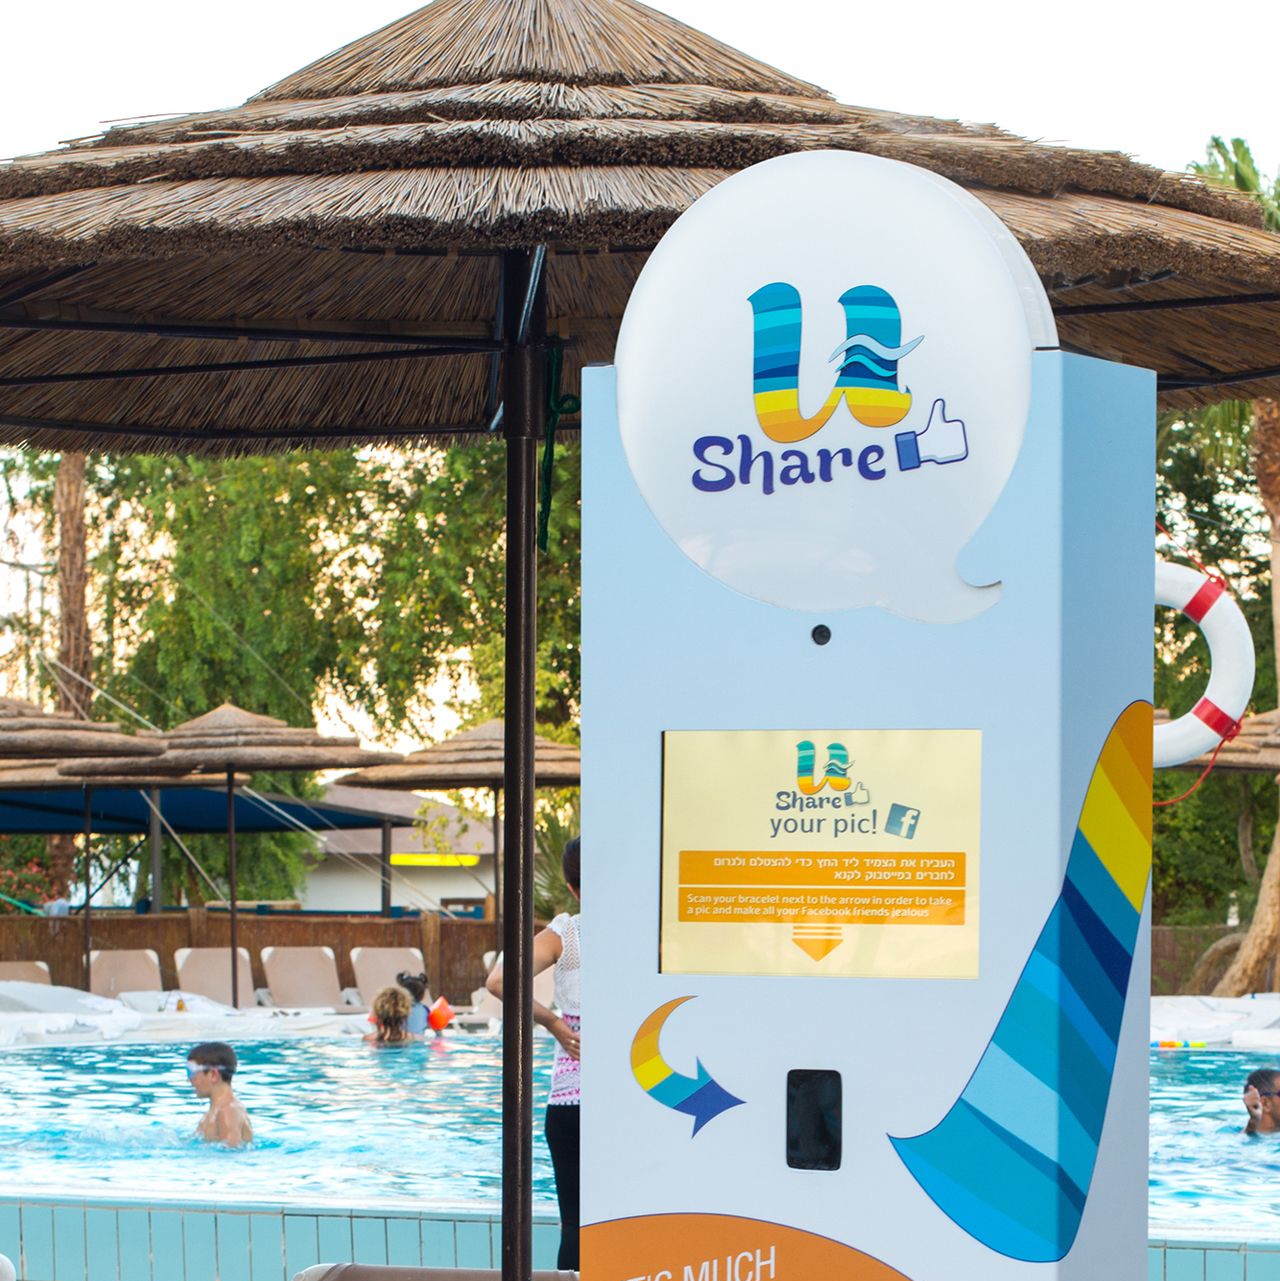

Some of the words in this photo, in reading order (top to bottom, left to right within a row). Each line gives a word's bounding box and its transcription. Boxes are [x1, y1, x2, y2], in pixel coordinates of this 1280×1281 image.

[691, 433, 887, 496] Share
[775, 790, 842, 812] Share
[770, 817, 827, 838] your
[833, 809, 877, 838] pic!
[713, 856, 746, 867] ולגרום
[749, 856, 792, 867] להצטלם
[795, 857, 813, 867] כדי
[816, 858, 838, 869] החץ
[842, 857, 859, 867] ליד
[863, 858, 897, 868] הצמיד
[900, 858, 917, 868] את
[919, 858, 956, 868] העבירו
[833, 870, 862, 881] לקנא
[864, 871, 912, 881] בפייסבוק
[915, 870, 956, 880] לחברים
[687, 893, 712, 903] Scan
[713, 895, 736, 905] your
[738, 894, 779, 904] bracelet
[781, 895, 805, 904] next
[806, 895, 818, 904] to
[819, 895, 837, 905] the
[838, 896, 870, 905] arrow
[871, 895, 882, 905] in
[883, 896, 914, 905] order
[915, 896, 927, 906] to
[928, 896, 953, 906] take
[695, 906, 711, 916] pic
[712, 906, 732, 915] and
[733, 906, 761, 915] make
[762, 906, 775, 915] all
[777, 907, 800, 917] your
[801, 906, 851, 916] Facebook
[852, 907, 890, 917] friends
[890, 907, 930, 918] jealous
